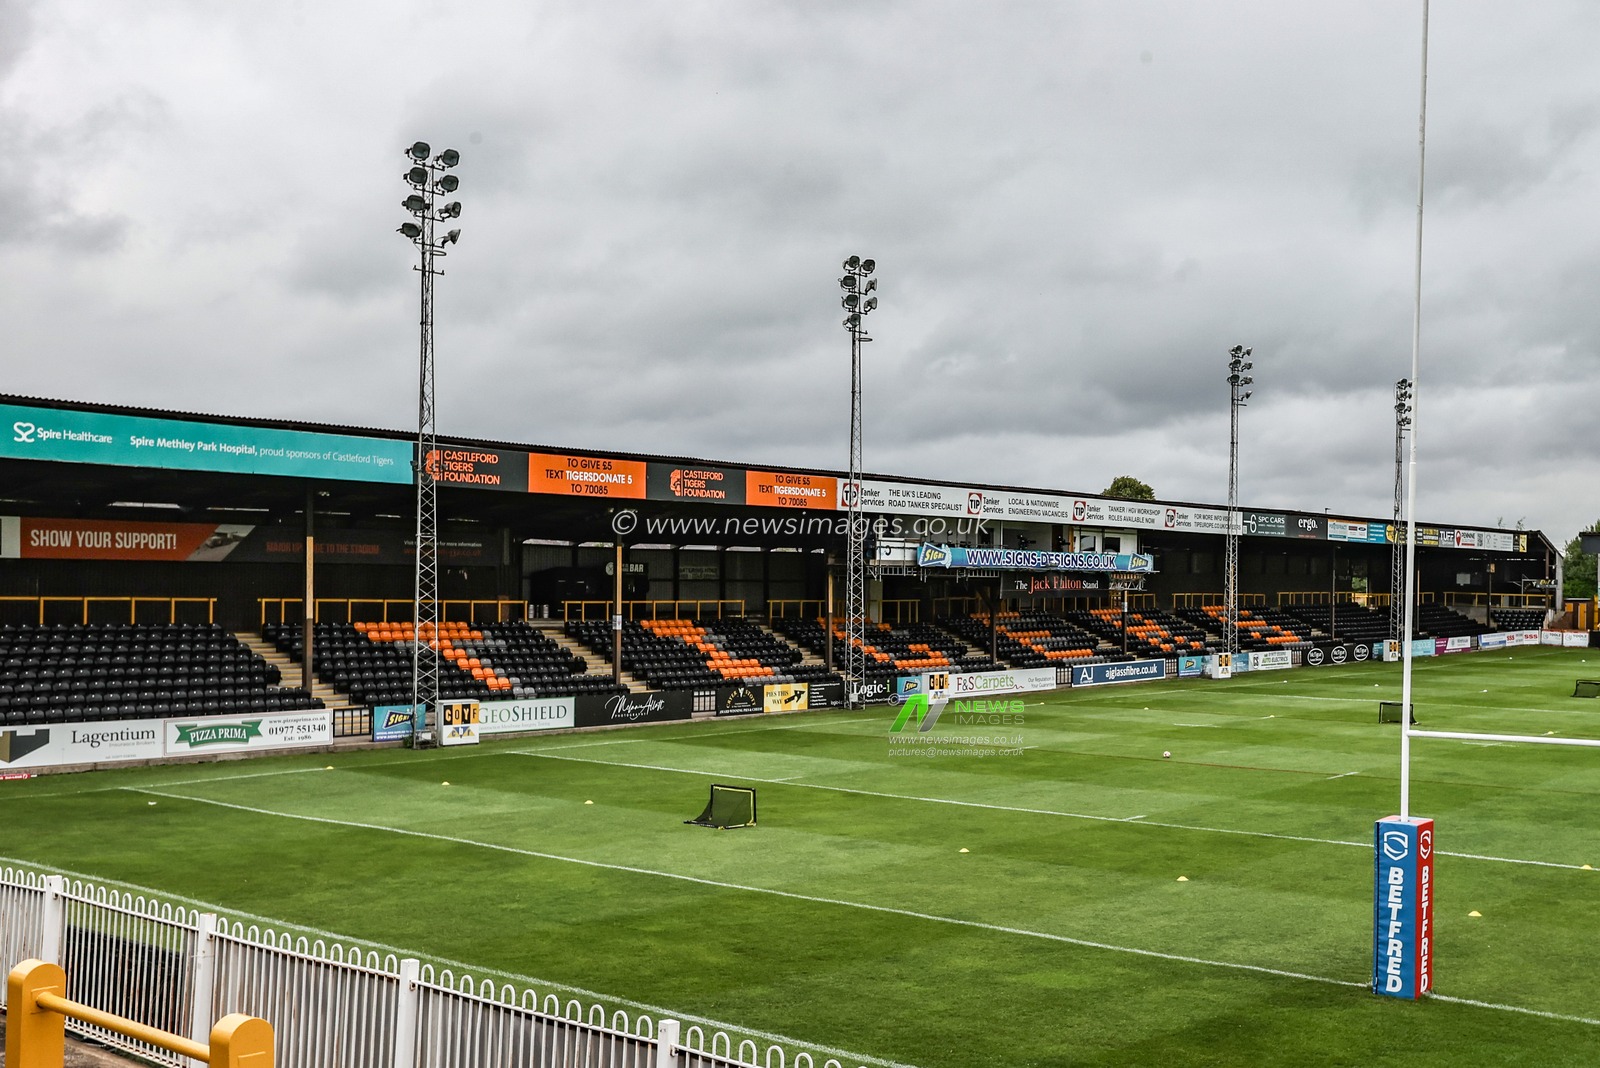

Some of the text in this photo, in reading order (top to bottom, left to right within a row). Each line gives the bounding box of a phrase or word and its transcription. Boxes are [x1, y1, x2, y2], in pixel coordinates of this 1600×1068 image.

[37, 428, 112, 443] Spire Healthcare
[130, 436, 394, 467] Spire Methley Park Hospital, proud sponsors of Castleford Tigers
[444, 451, 499, 464] CASTLEFORD
[444, 462, 474, 472] TIGERS
[567, 458, 613, 470] TO GIVE £5
[444, 472, 500, 485] FOUNDATION
[545, 469, 633, 485] TEXT TIGERSDONATE 5
[683, 469, 724, 481] CASTLEFORD
[775, 475, 784, 483] TO
[785, 476, 802, 485] GIVE
[683, 479, 706, 488] TIGERS
[571, 484, 609, 495] TO 70085
[683, 488, 726, 499] FOUNDATION
[758, 485, 827, 498] TEXT TIGERSDONATE 5
[860, 488, 881, 498] Tanker
[888, 489, 942, 500] THE UK'S LEADING
[844, 490, 857, 501] TP
[982, 497, 1000, 505] Tanker
[778, 497, 808, 507] TO 70085
[860, 498, 885, 507] Services
[888, 500, 963, 511] ROAD TANKER SPECIALIST
[969, 499, 980, 510] TIP
[1008, 498, 1026, 506] LOCAL
[1030, 500, 1060, 508] NATIONWIDE
[982, 505, 1004, 514] Services
[1008, 507, 1069, 518] ENGINEERING VACANCIES
[1074, 507, 1085, 516] TIP
[1086, 504, 1101, 513] Tanker
[1086, 512, 1105, 521] Services
[1167, 514, 1175, 523] TIP
[31, 530, 177, 550] SHOW YOUR SUPPORT!
[966, 549, 1117, 570] WWW.SIGNS-DESIGNS.CO.UK
[629, 563, 644, 573] BAR
[1015, 580, 1028, 590] The
[1028, 576, 1050, 594] Jack
[1082, 580, 1099, 590] Stand
[1080, 663, 1158, 681] AJ ajglassfibre.co.uk
[852, 679, 891, 698] Logic-i
[445, 707, 477, 722] COYF
[268, 723, 327, 736] 01977 551340
[71, 728, 155, 748] Lagentium
[190, 728, 247, 743] PIZZA PRIMA
[1385, 866, 1404, 993] BETFRED
[1420, 865, 1429, 993] BETFRED
